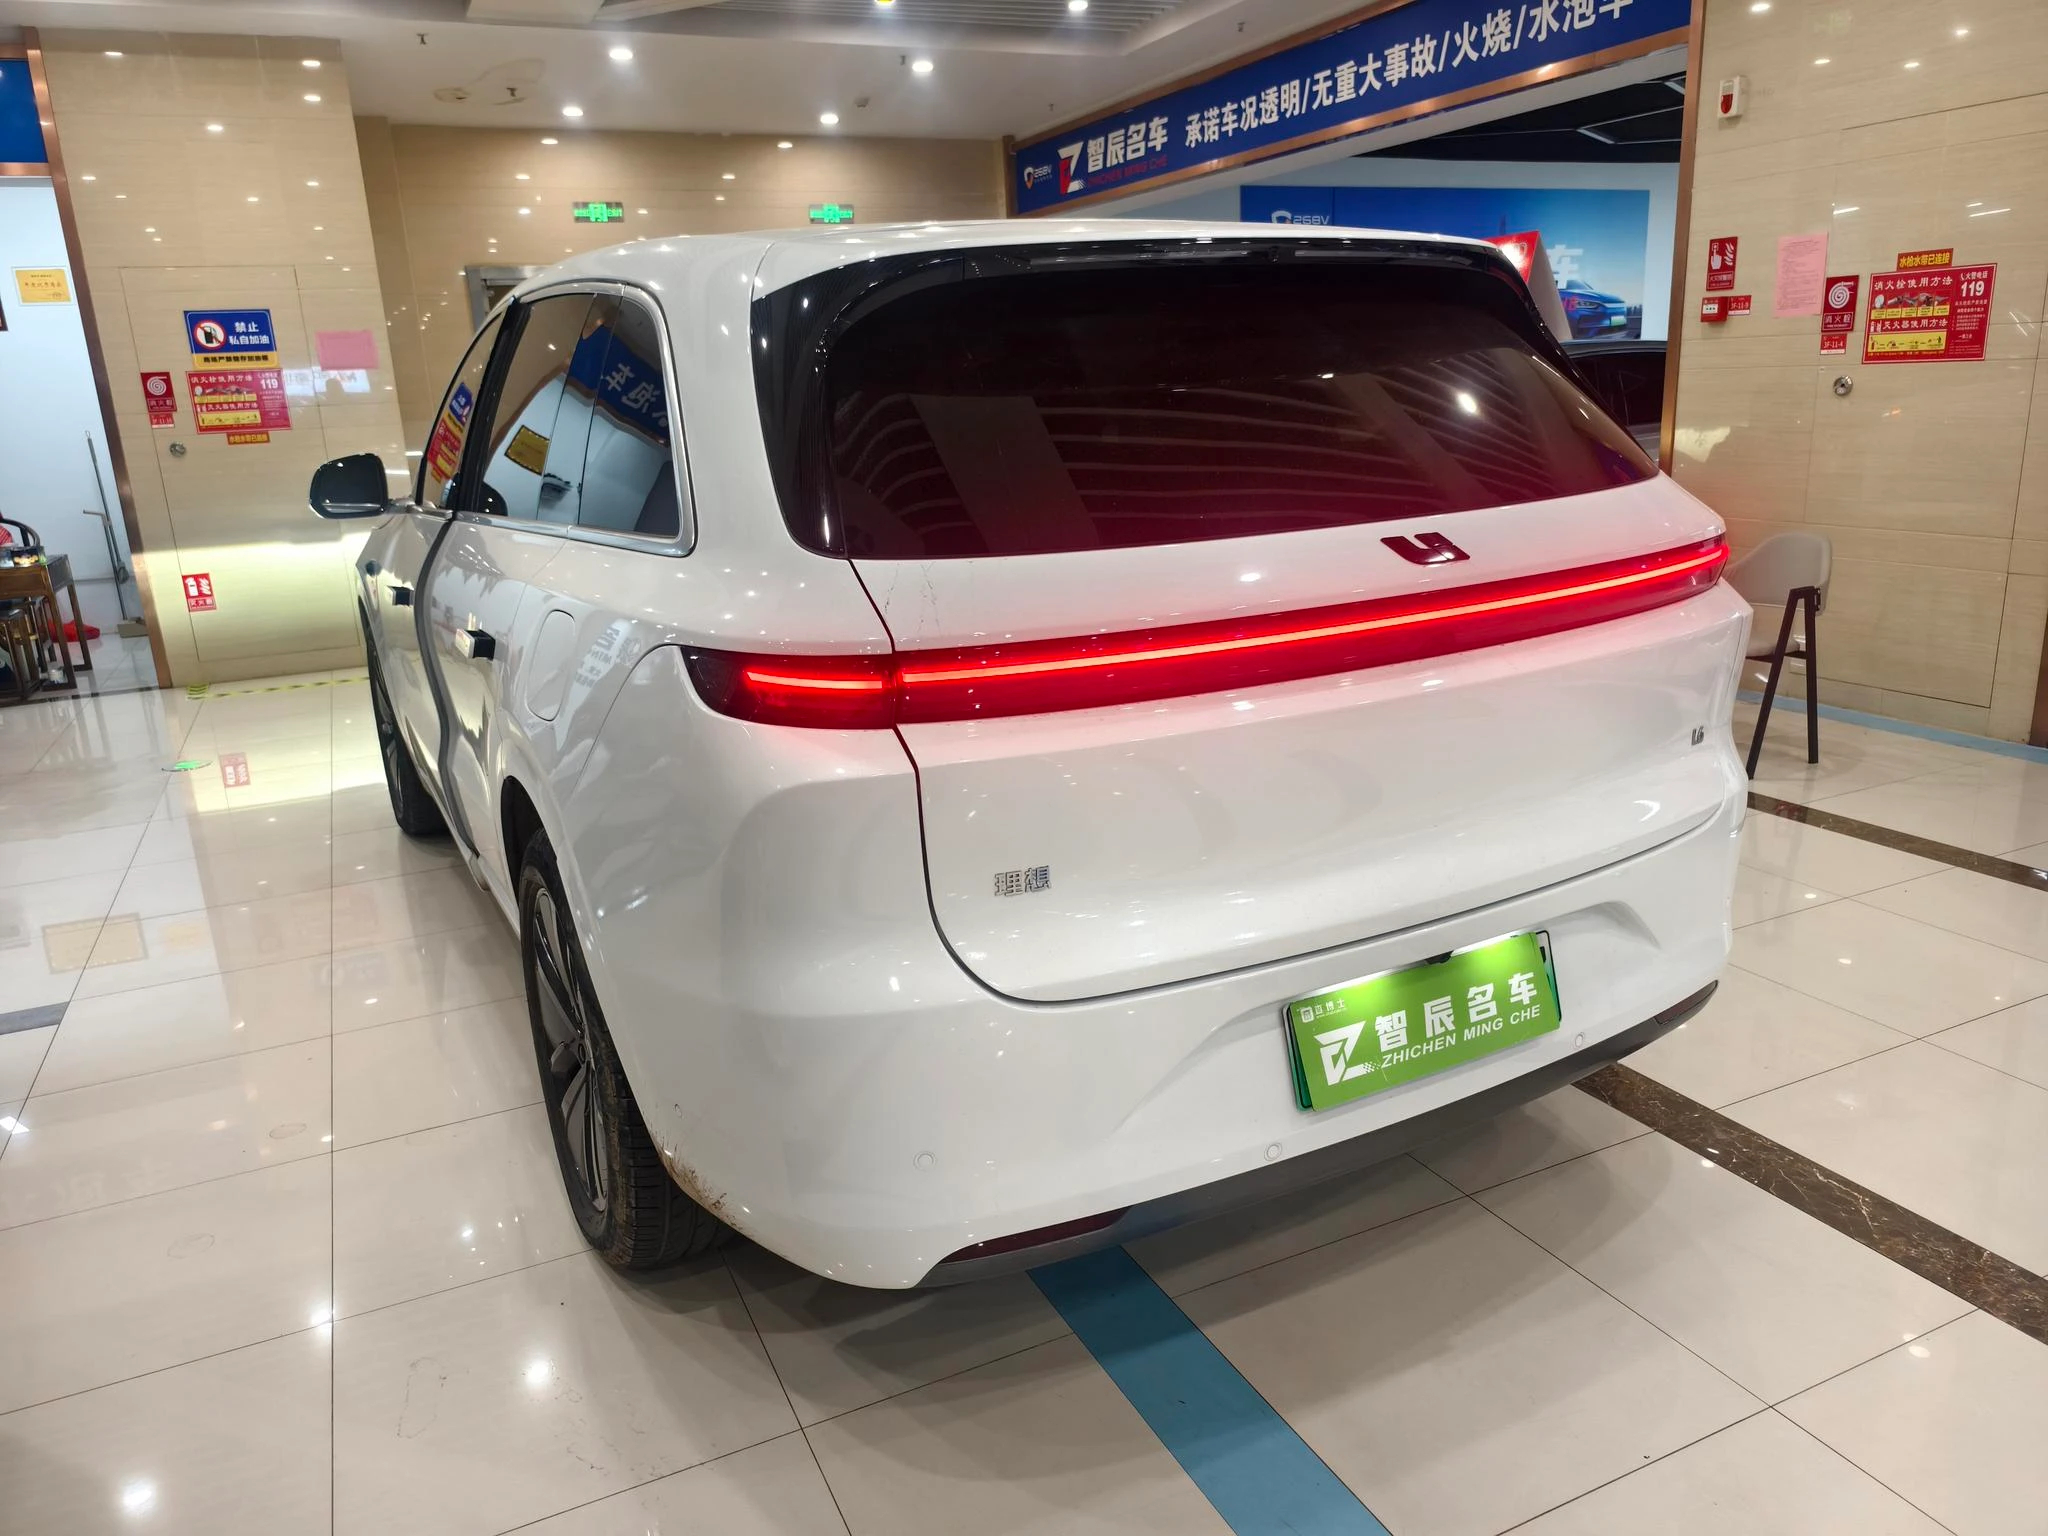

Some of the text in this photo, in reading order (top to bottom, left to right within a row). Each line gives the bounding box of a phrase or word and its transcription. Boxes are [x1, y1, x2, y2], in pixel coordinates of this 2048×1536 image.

[1086, 116, 1169, 173] 智辰名车
[1293, 215, 1330, 225] 268V
[1874, 276, 1953, 290] 消火栓使用方法
[1961, 281, 1985, 297] 119
[234, 321, 259, 333] 禁止
[228, 335, 270, 345] 私自加油
[260, 378, 279, 390] 119
[994, 865, 1051, 897] 理想
[1374, 971, 1538, 1052] 智辰名车
[1381, 1004, 1541, 1068] ZHICHEN MING CHE
